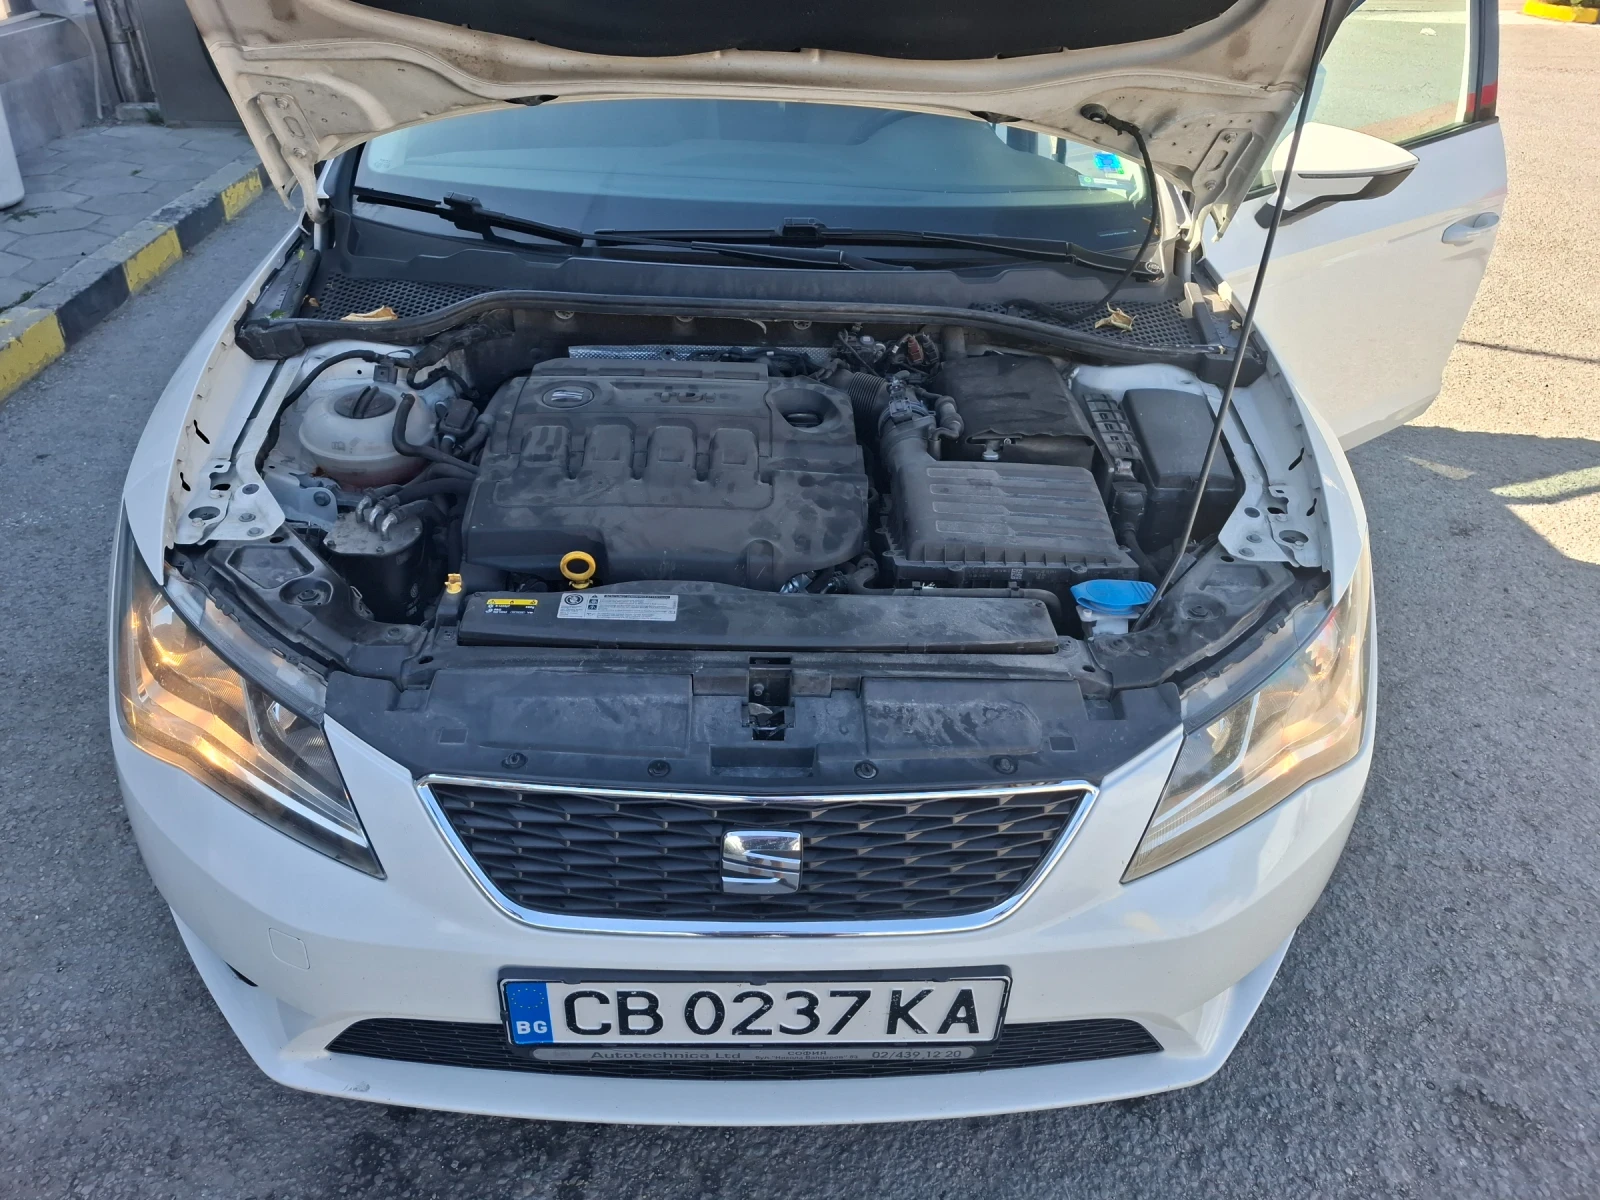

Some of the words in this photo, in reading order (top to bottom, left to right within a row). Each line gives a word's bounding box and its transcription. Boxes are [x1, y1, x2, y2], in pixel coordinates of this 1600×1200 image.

[563, 990, 664, 1036] CB
[683, 989, 872, 1036] 0237
[885, 988, 980, 1035] KA
[516, 1021, 548, 1035] BG
[590, 1051, 710, 1059] Autotechnica
[926, 1050, 941, 1059] 12
[945, 1050, 962, 1058] 20
